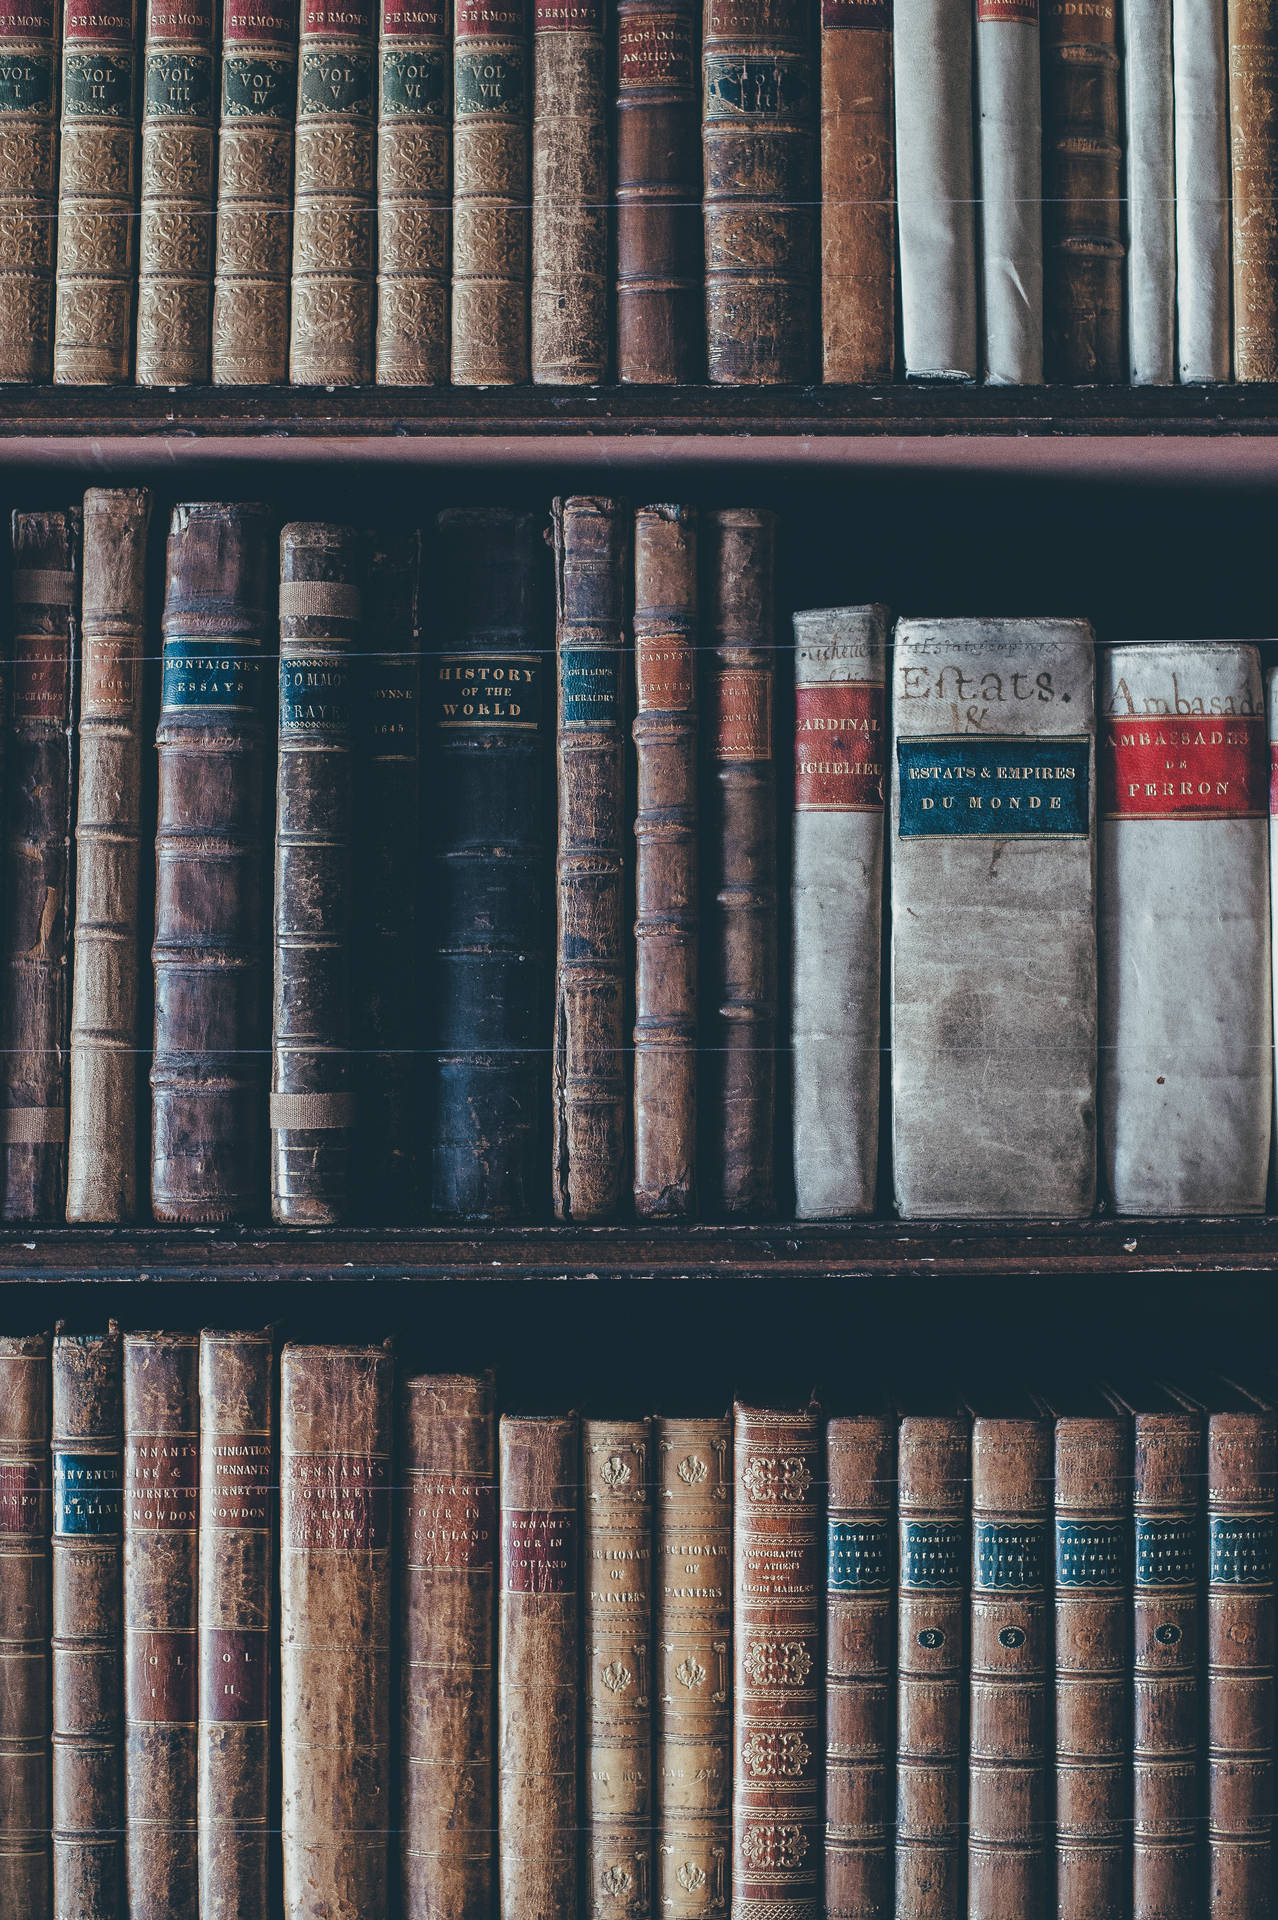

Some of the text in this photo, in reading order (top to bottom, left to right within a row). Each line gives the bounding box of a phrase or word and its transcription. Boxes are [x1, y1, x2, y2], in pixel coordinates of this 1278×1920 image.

[308, 11, 369, 25] SERMONS
[384, 11, 445, 25] SERMONS
[460, 9, 523, 24] SERMONS
[537, 8, 601, 19] SERMONS
[71, 15, 131, 28] SERMONS
[151, 15, 211, 28] SERMONS
[231, 15, 290, 30] SERMONS
[0, 66, 34, 82] VOL
[82, 68, 117, 84] VOL
[159, 67, 194, 82] VOL
[318, 67, 355, 83] VOL
[395, 64, 429, 80] VOL
[472, 64, 507, 80] VOL
[240, 73, 276, 89] VOL
[90, 85, 106, 99] II
[329, 84, 342, 99] V
[404, 83, 422, 98] VI
[252, 91, 269, 105] IV
[439, 666, 537, 683] HISTORY
[176, 681, 245, 692] ESSAYS
[461, 687, 513, 697] OF THE
[641, 682, 691, 692] TRAVELS
[441, 703, 522, 718] WORLD
[1104, 730, 1250, 747] AMBASSADES
[1164, 760, 1188, 769] DE
[908, 766, 1077, 780] ESTATS & EMPIRES
[1128, 782, 1230, 797] PERRON
[921, 796, 1063, 810] DU MONDE
[170, 1466, 182, 1479] &
[184, 1488, 197, 1499] TO
[308, 1510, 355, 1521] FROM
[407, 1507, 480, 1519] TOUR IN
[550, 1539, 564, 1548] IN
[743, 1549, 804, 1558] TOPOGRAPHY
[684, 1563, 701, 1575] OF
[748, 1562, 801, 1571] OF ATHENS
[609, 1569, 625, 1581] OF
[590, 1591, 647, 1603] PAINTERS
[664, 1586, 723, 1598] PAINTERS
[926, 1630, 937, 1645] 2
[1005, 1628, 1016, 1645] 3
